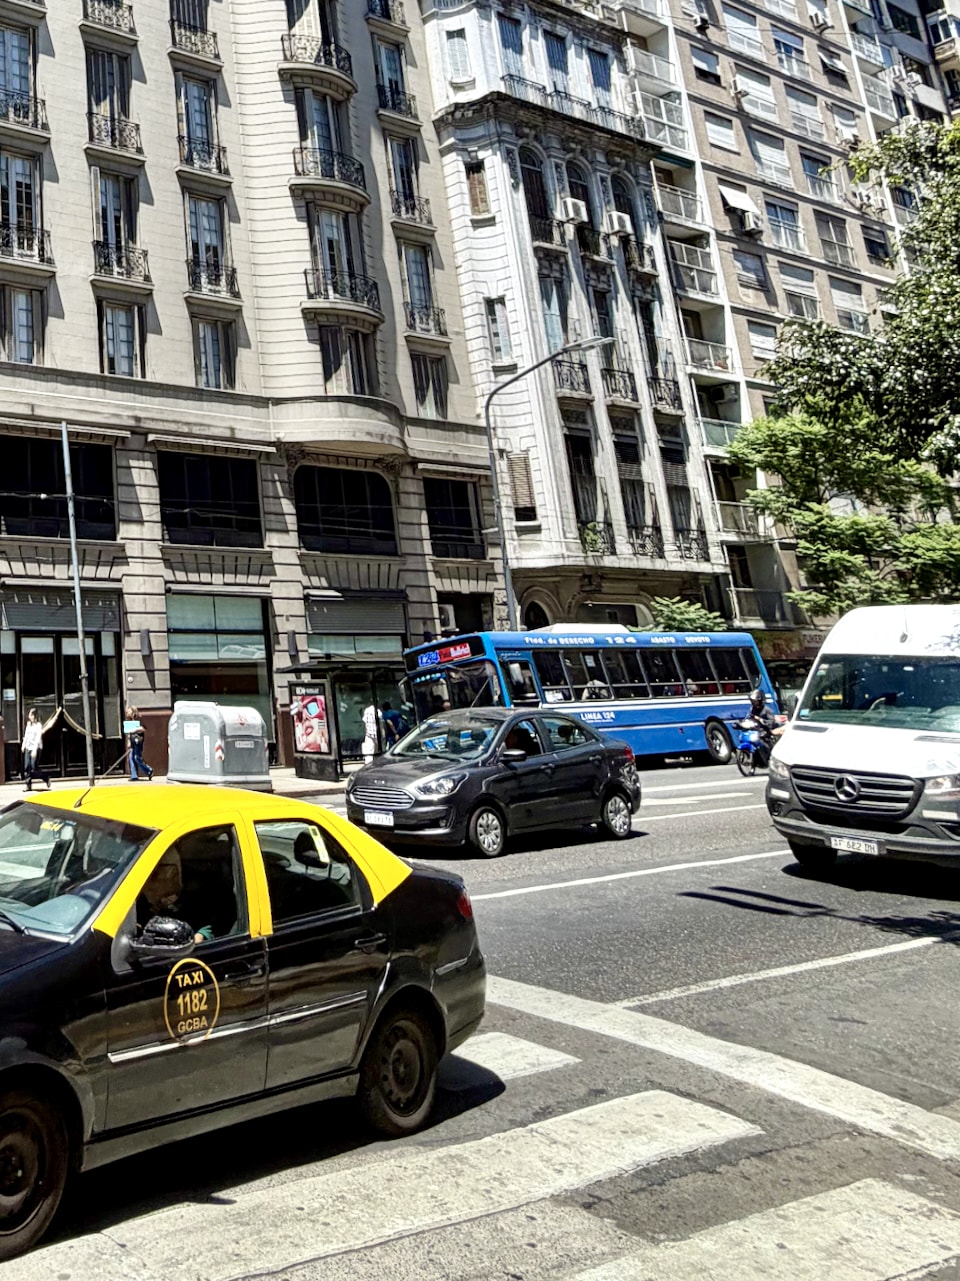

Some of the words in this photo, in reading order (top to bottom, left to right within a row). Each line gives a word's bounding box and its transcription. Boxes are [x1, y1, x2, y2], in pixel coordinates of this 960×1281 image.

[559, 637, 595, 645] DERECHO
[580, 712, 602, 720] LINEA
[175, 971, 204, 988] TAXI
[177, 989, 208, 1016] 1182
[177, 1015, 208, 1033] GCBA
